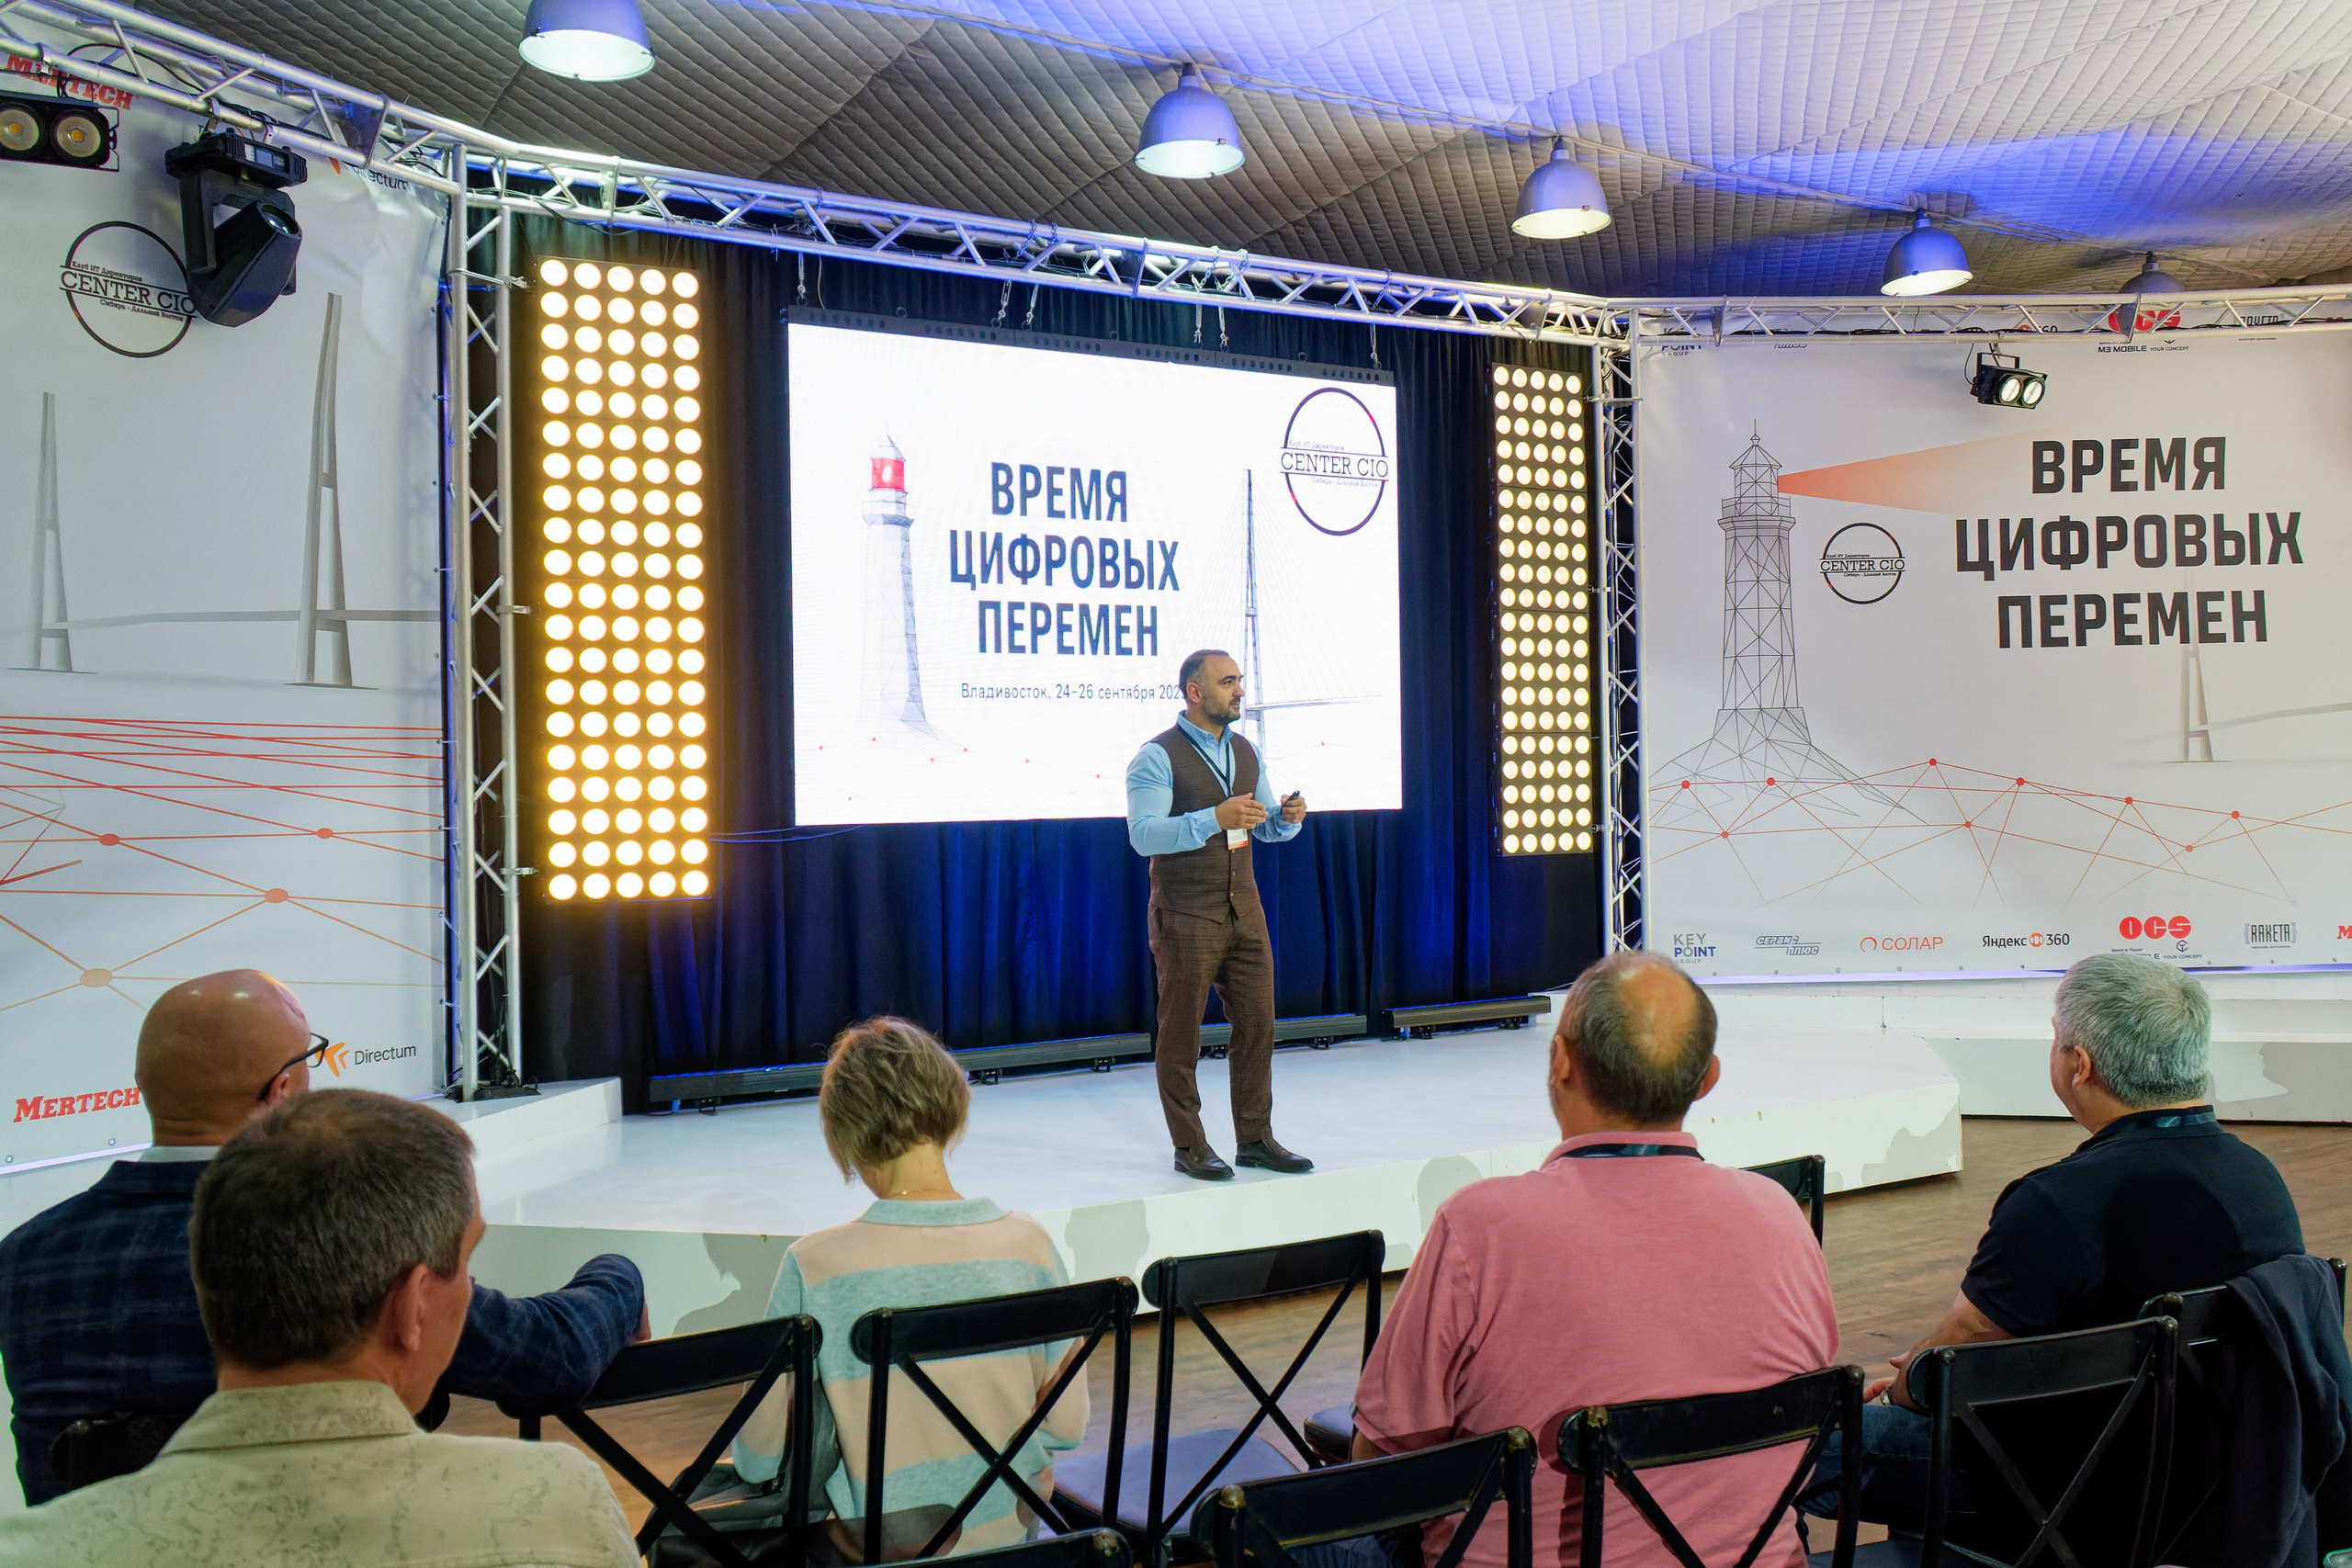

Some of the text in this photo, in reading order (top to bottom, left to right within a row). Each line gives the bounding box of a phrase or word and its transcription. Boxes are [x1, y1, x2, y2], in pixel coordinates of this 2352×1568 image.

[72, 261, 143, 282] Клуб ИТ Директоров
[61, 270, 196, 314] CENTER CIO
[100, 299, 126, 310] Сибирь
[1281, 452, 1388, 478] CENTER CIO
[2031, 436, 2226, 494] ВРЕМЯ
[990, 461, 1127, 523] ВРЕМЯ
[1956, 512, 2304, 581] ЦИФРОВЫХ
[949, 529, 1181, 592] ЦИФРОВЫХ
[1820, 559, 1905, 571] CENTER CIO
[978, 600, 1158, 657] ПЕРЕМЕН
[1997, 590, 2267, 649] ПЕРЕМЕН
[961, 682, 1051, 702] Владивосток,
[1098, 683, 1155, 703] сентября
[1159, 684, 1184, 699] 202
[2119, 915, 2191, 940] OCS
[2251, 923, 2290, 942] RAKETA
[1673, 933, 1706, 946] KEY
[1756, 935, 1799, 945] СЕРВИС
[1882, 936, 1943, 951] СОЛАР
[1982, 933, 2070, 948] Яндекс 360
[1674, 946, 1716, 958] POINT
[355, 1045, 416, 1065] Directum
[13, 1087, 141, 1122] MERTECH
